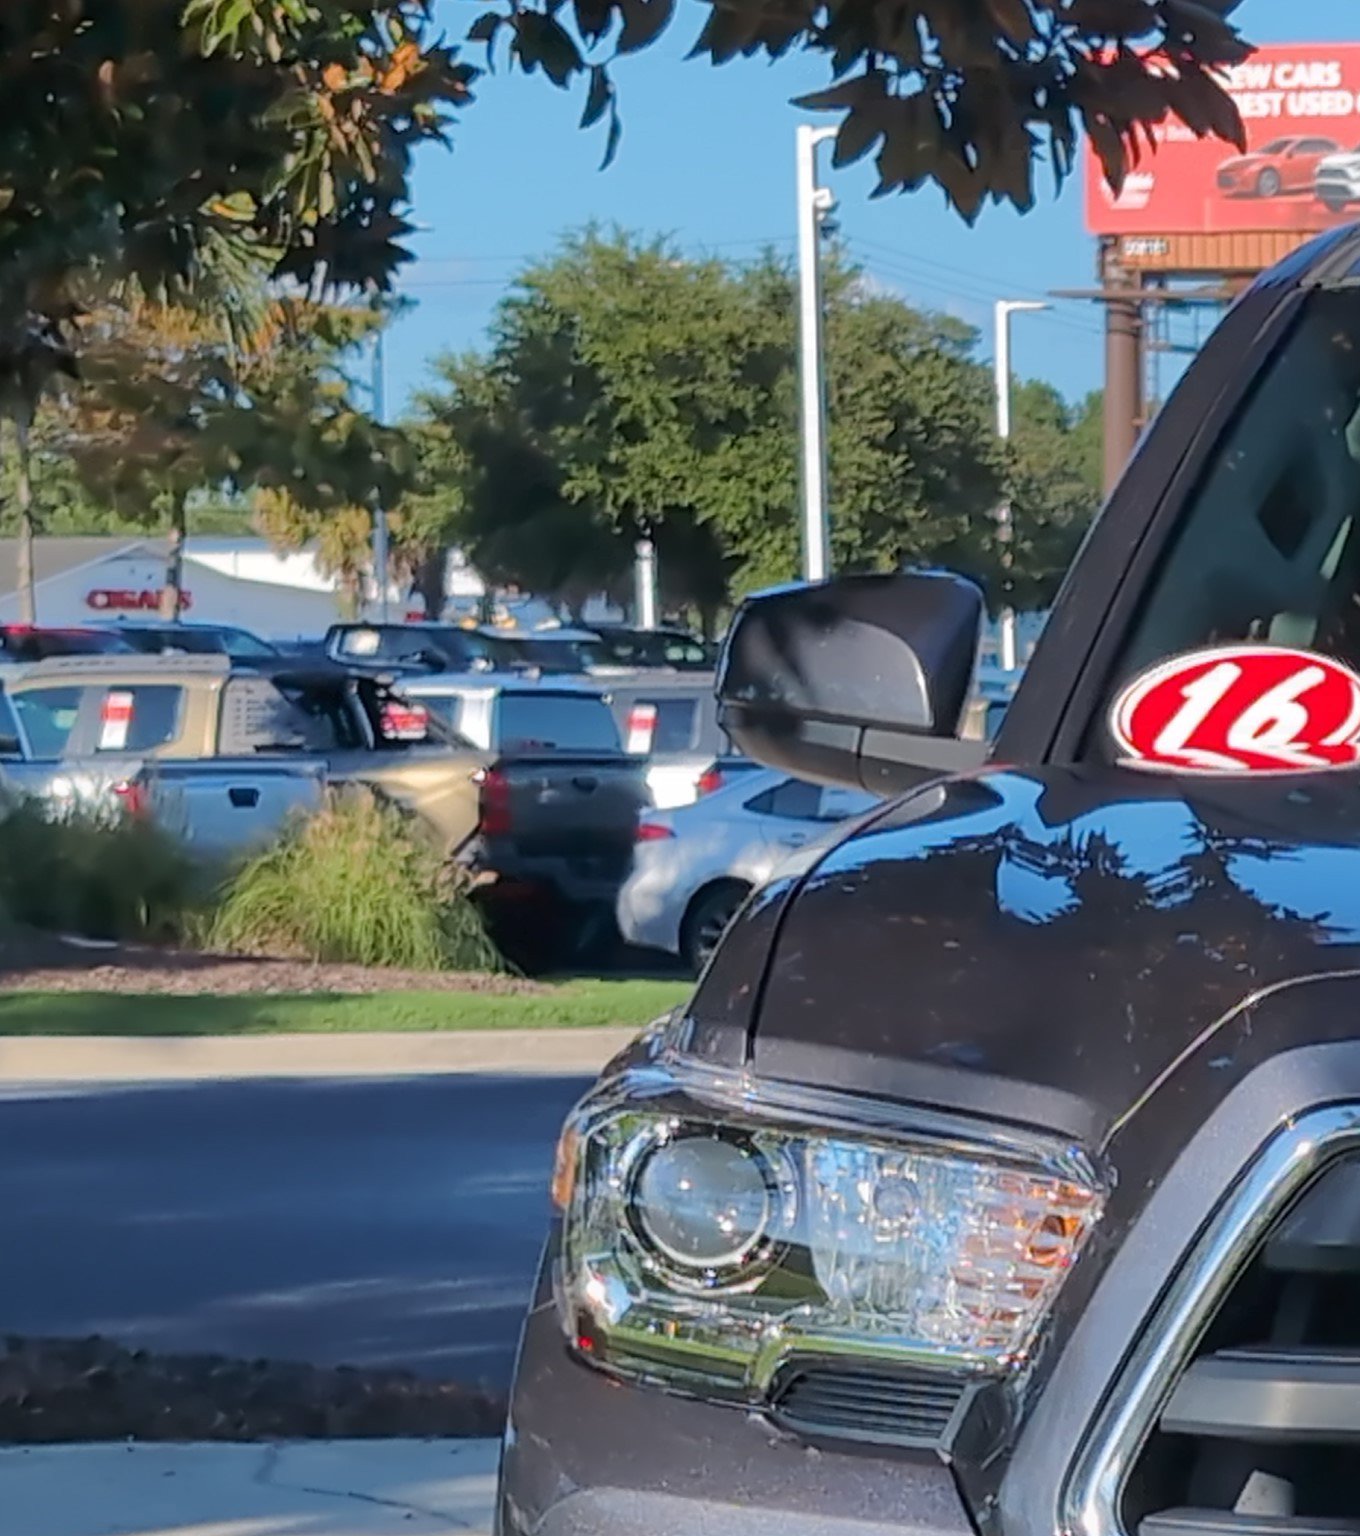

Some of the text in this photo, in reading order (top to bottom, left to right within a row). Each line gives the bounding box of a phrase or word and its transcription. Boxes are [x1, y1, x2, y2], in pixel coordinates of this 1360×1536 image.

[1275, 62, 1341, 87] CARS
[1287, 90, 1354, 116] USED
[1152, 660, 1330, 766] 16
